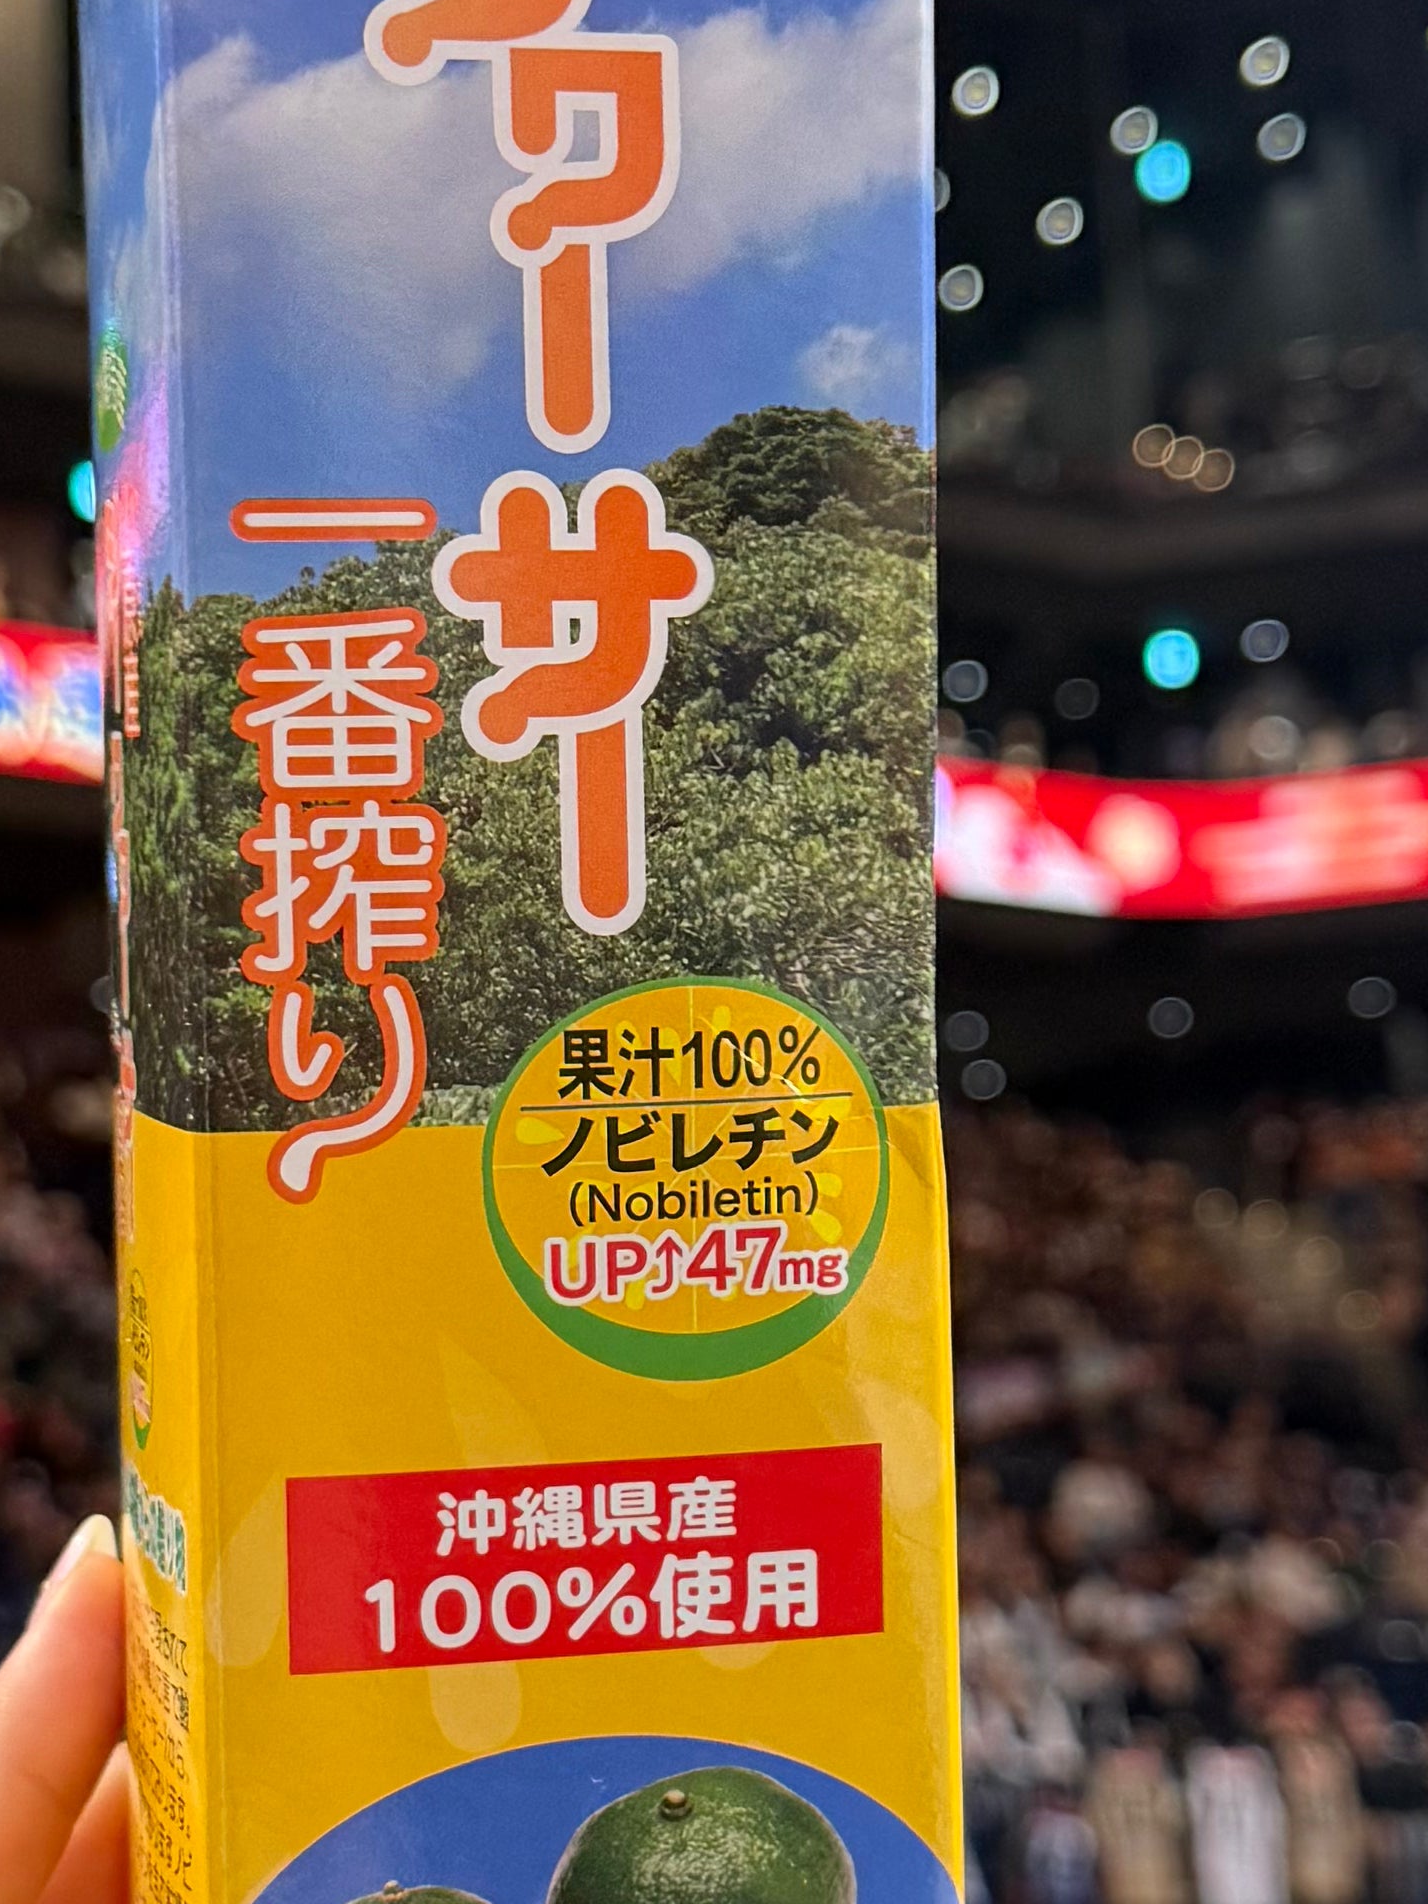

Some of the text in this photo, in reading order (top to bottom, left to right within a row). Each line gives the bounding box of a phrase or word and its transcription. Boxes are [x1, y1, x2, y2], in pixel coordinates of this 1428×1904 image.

[229, 498, 448, 1204] 一番搾り
[557, 1024, 821, 1100] 果汁100%
[541, 1107, 840, 1177] ノビレチン
[569, 1170, 820, 1227] (Nobiletin)
[435, 1475, 738, 1557] 沖縄県産
[363, 1548, 820, 1653] 100%使用
